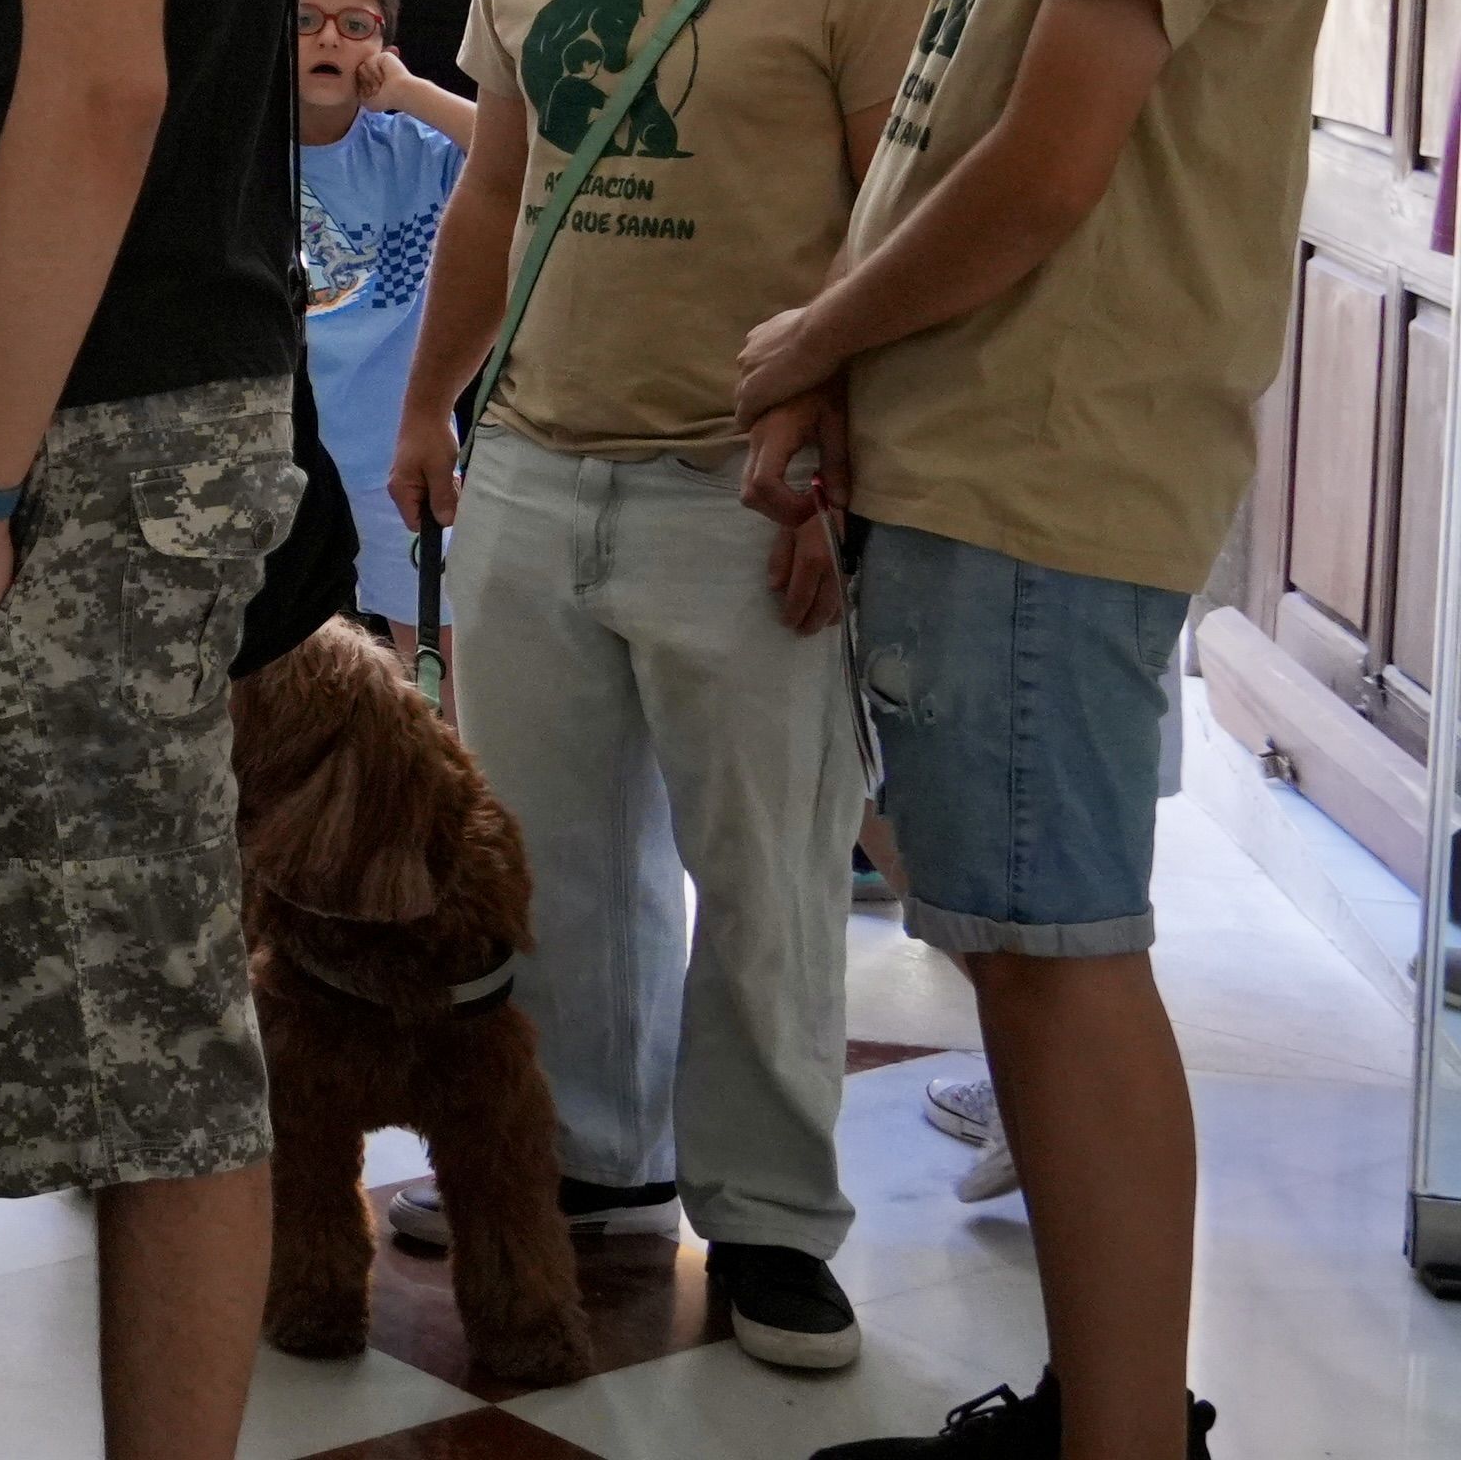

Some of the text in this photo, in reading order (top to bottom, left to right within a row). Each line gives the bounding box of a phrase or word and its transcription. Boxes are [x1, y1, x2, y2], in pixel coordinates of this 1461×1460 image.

[544, 171, 655, 202] AIACIÓN
[571, 210, 612, 234] QUE
[615, 213, 696, 240] SANAN
